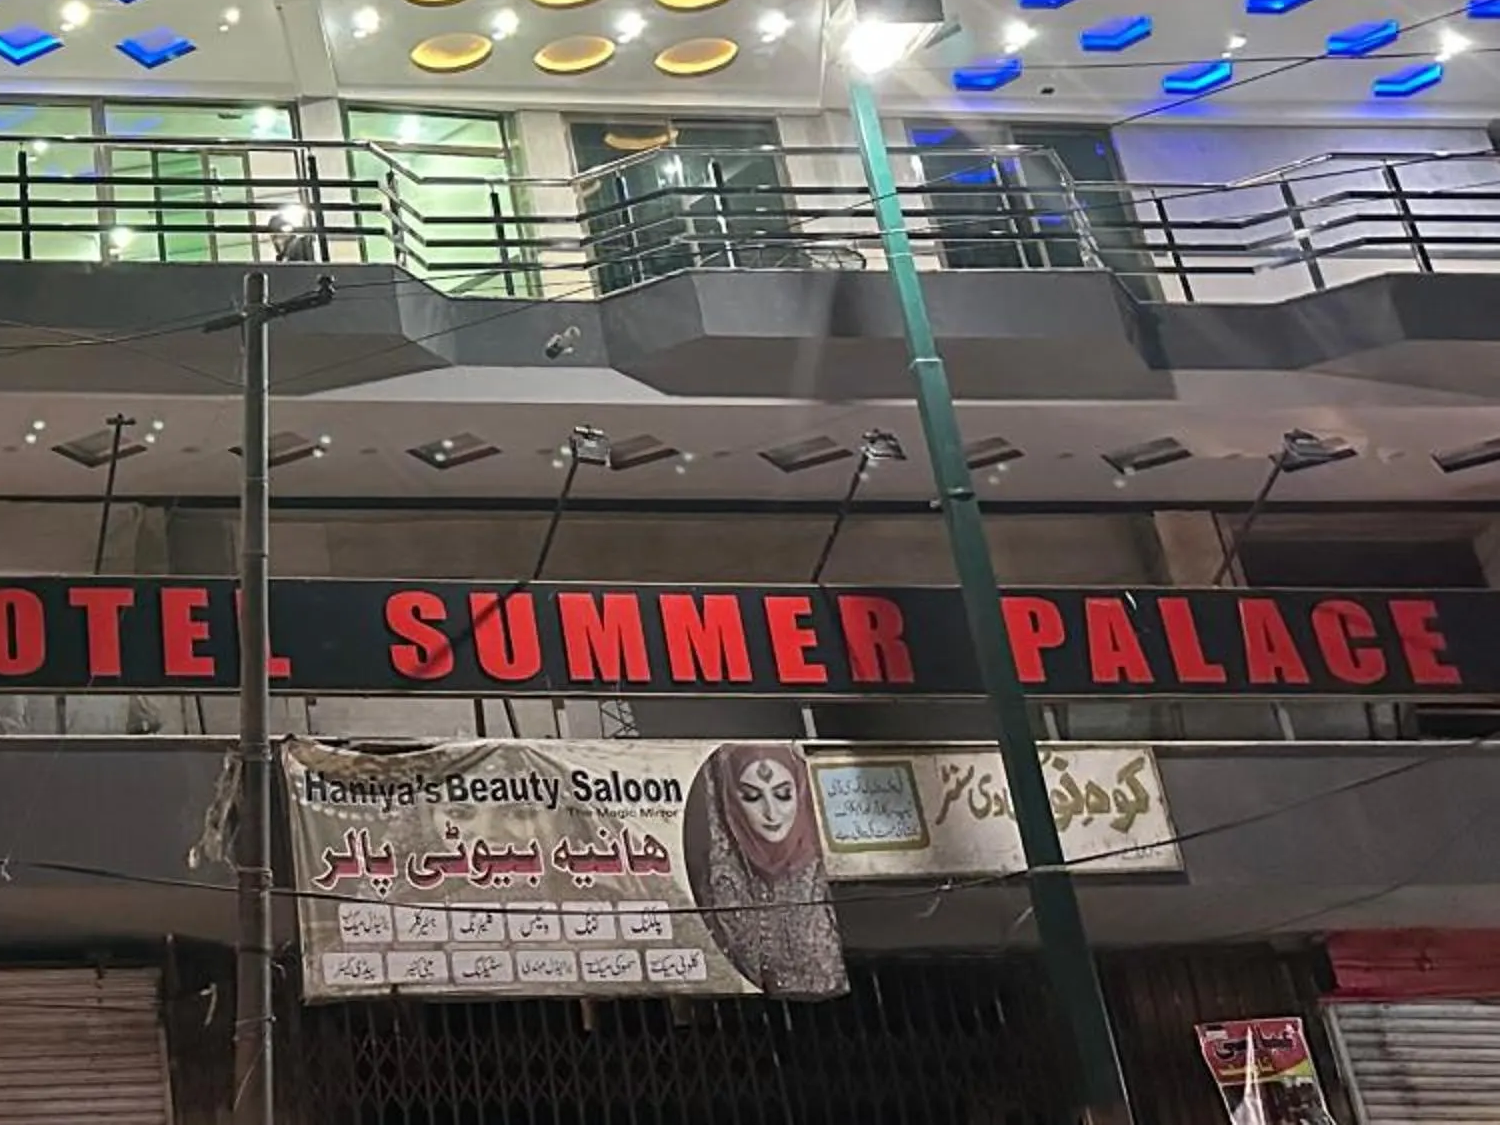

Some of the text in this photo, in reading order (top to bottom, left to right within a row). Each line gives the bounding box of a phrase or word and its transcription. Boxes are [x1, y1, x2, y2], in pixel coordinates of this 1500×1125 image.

[386, 590, 915, 684] SUMMER
[999, 595, 1463, 685] PALACE
[304, 769, 684, 813] Haniya's Beauty Saloon
[311, 826, 399, 897] پالر
[405, 823, 546, 889] بیوٹی
